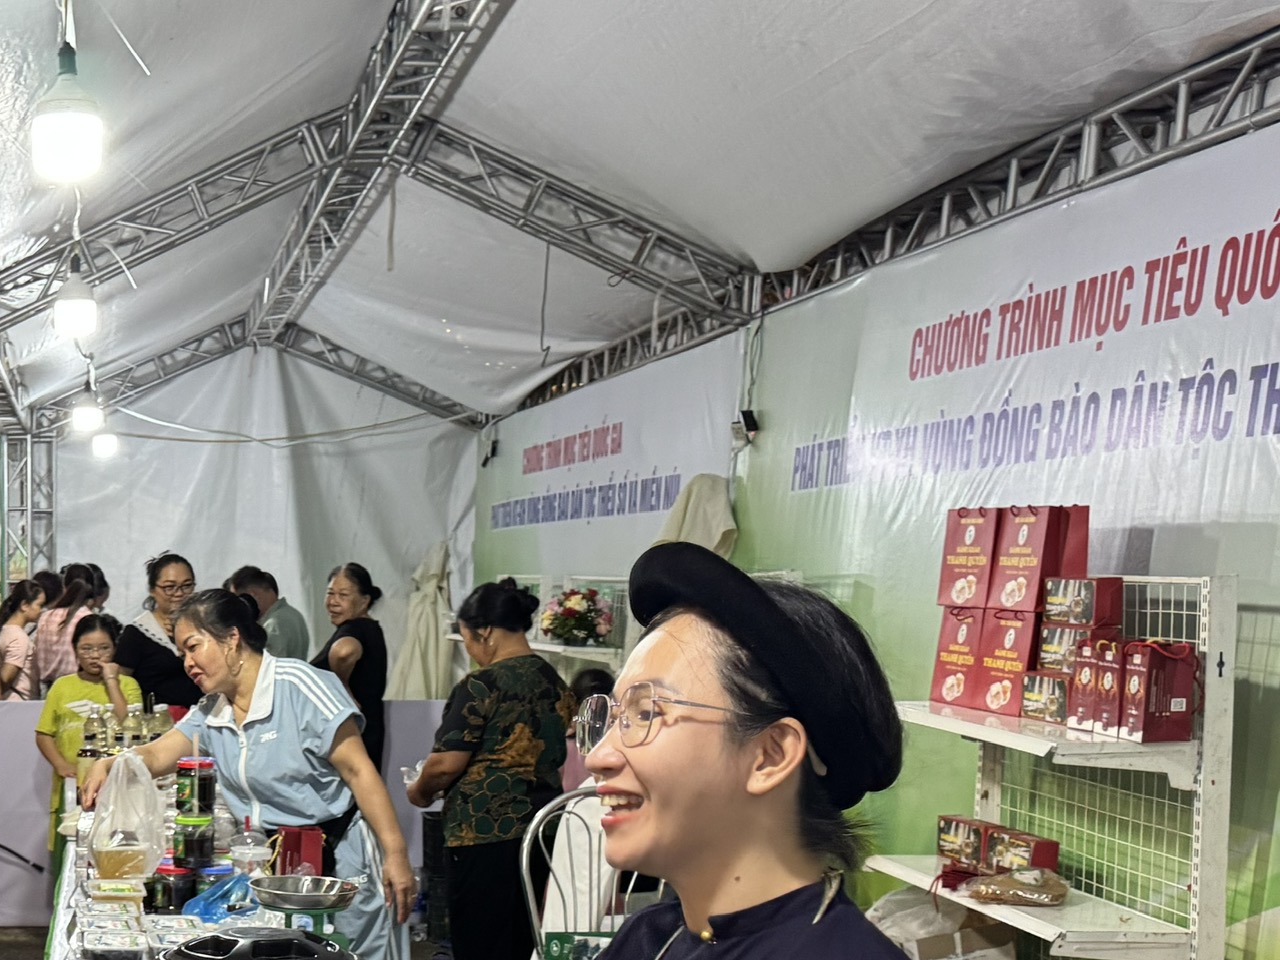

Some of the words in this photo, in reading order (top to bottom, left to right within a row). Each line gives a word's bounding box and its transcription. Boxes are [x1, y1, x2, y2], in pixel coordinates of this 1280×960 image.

[909, 308, 992, 382] CHƯƠNG
[995, 282, 1066, 361] TRÌNH
[1069, 264, 1135, 352] MỤC
[1141, 236, 1211, 327] TIÊU
[791, 433, 824, 491] PHÁT
[922, 409, 976, 475] VÙNG
[978, 388, 1043, 470] ĐỒNG
[1045, 381, 1100, 462] BÀO
[1104, 370, 1169, 454] DÂN
[1173, 357, 1238, 460] TỘC
